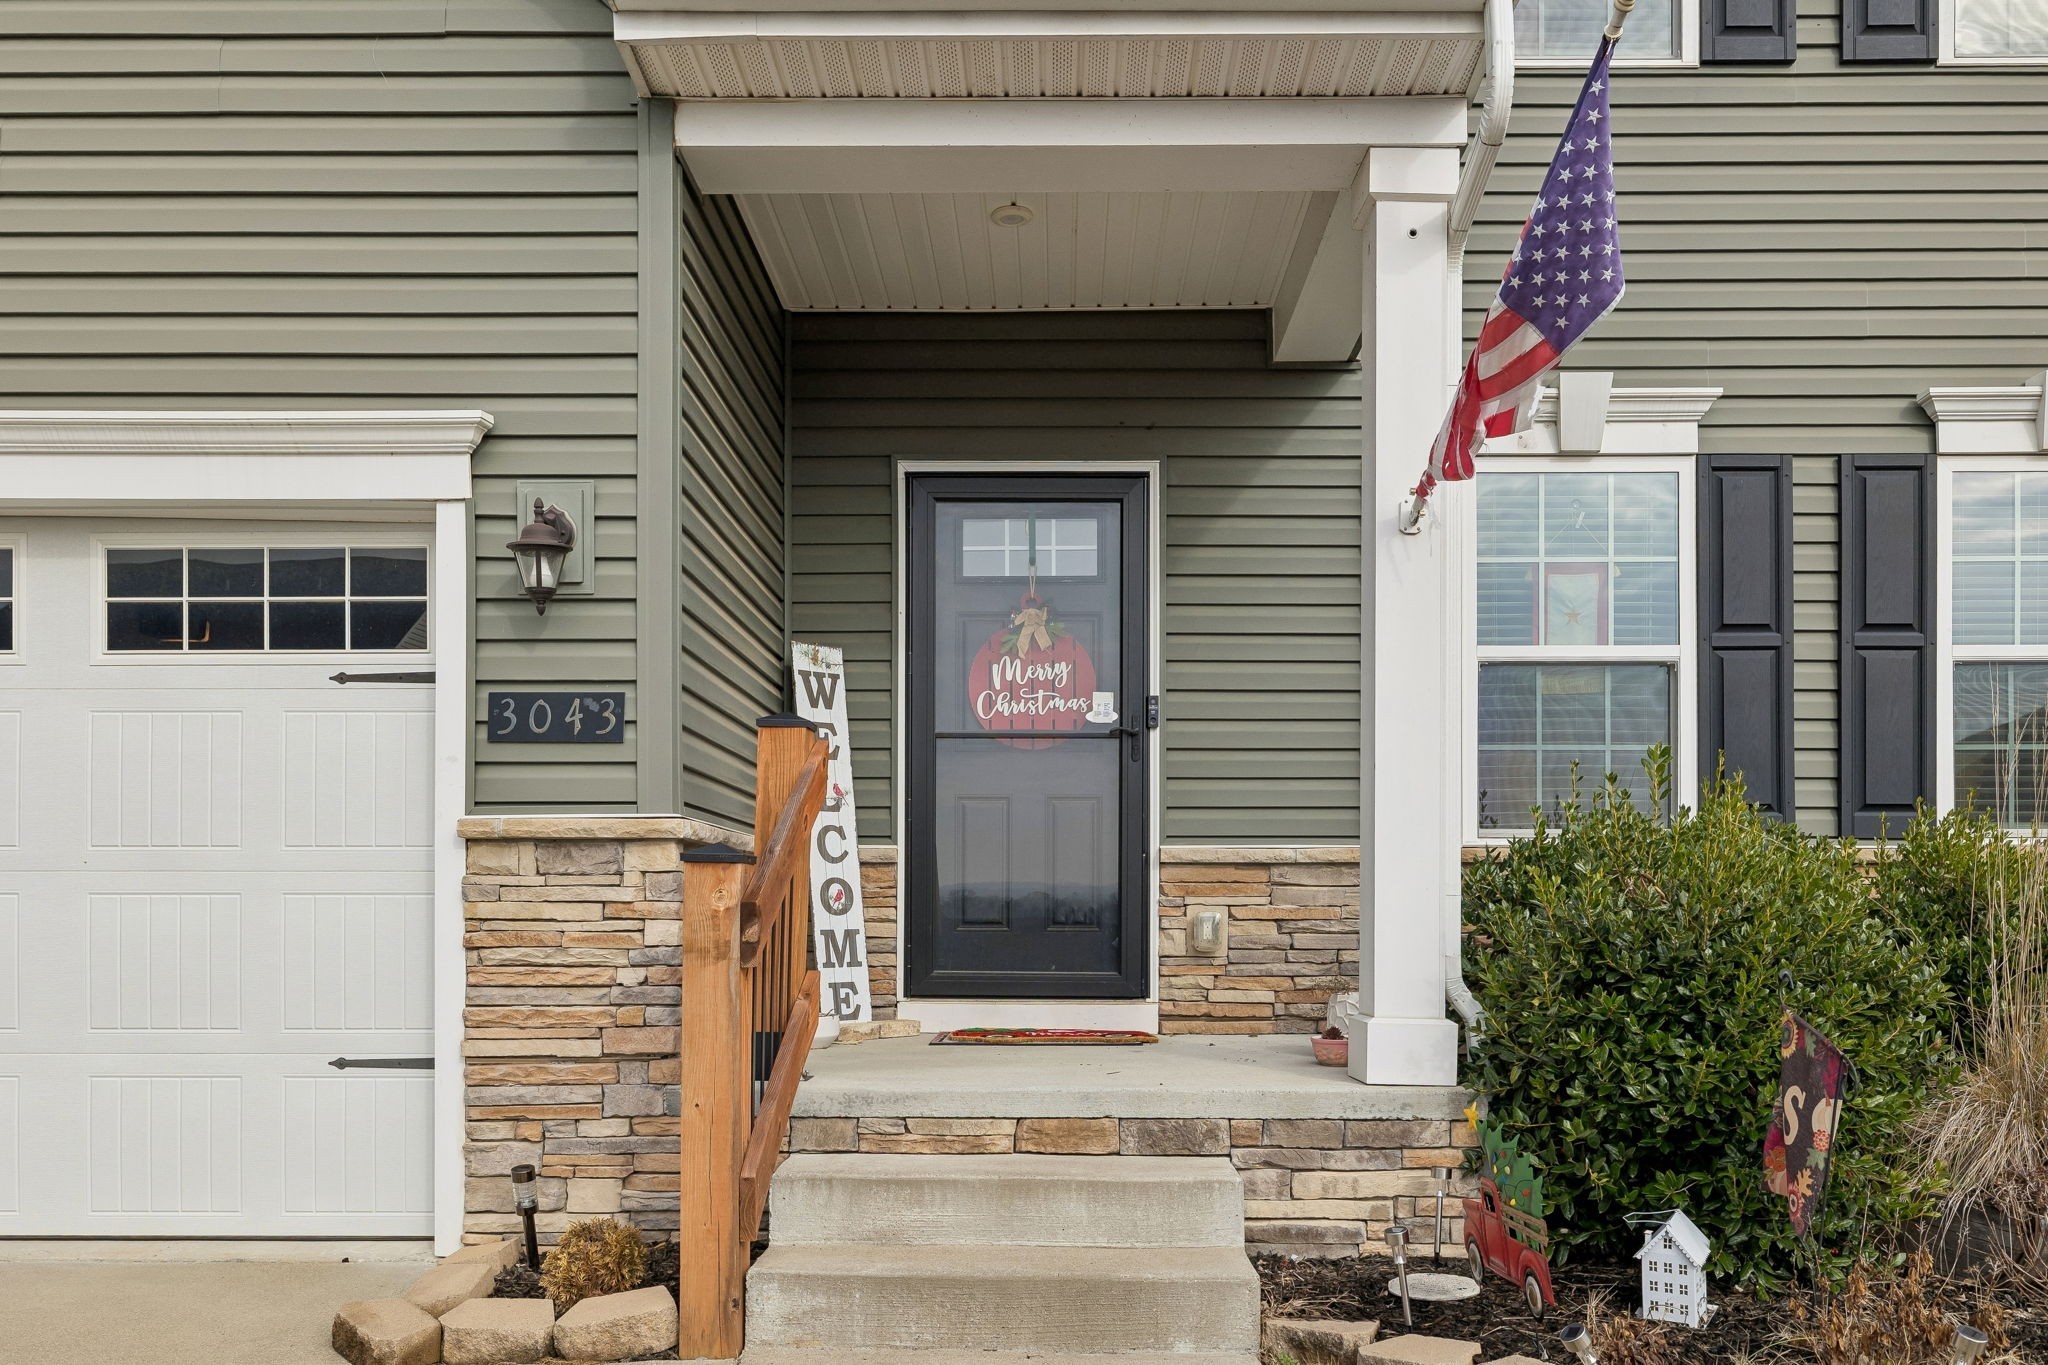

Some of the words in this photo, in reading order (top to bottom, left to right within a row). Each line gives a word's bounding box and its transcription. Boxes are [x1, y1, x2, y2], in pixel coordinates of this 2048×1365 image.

[992, 655, 1072, 690] Merry
[497, 698, 616, 735] 3043
[977, 688, 1091, 720] Christmas
